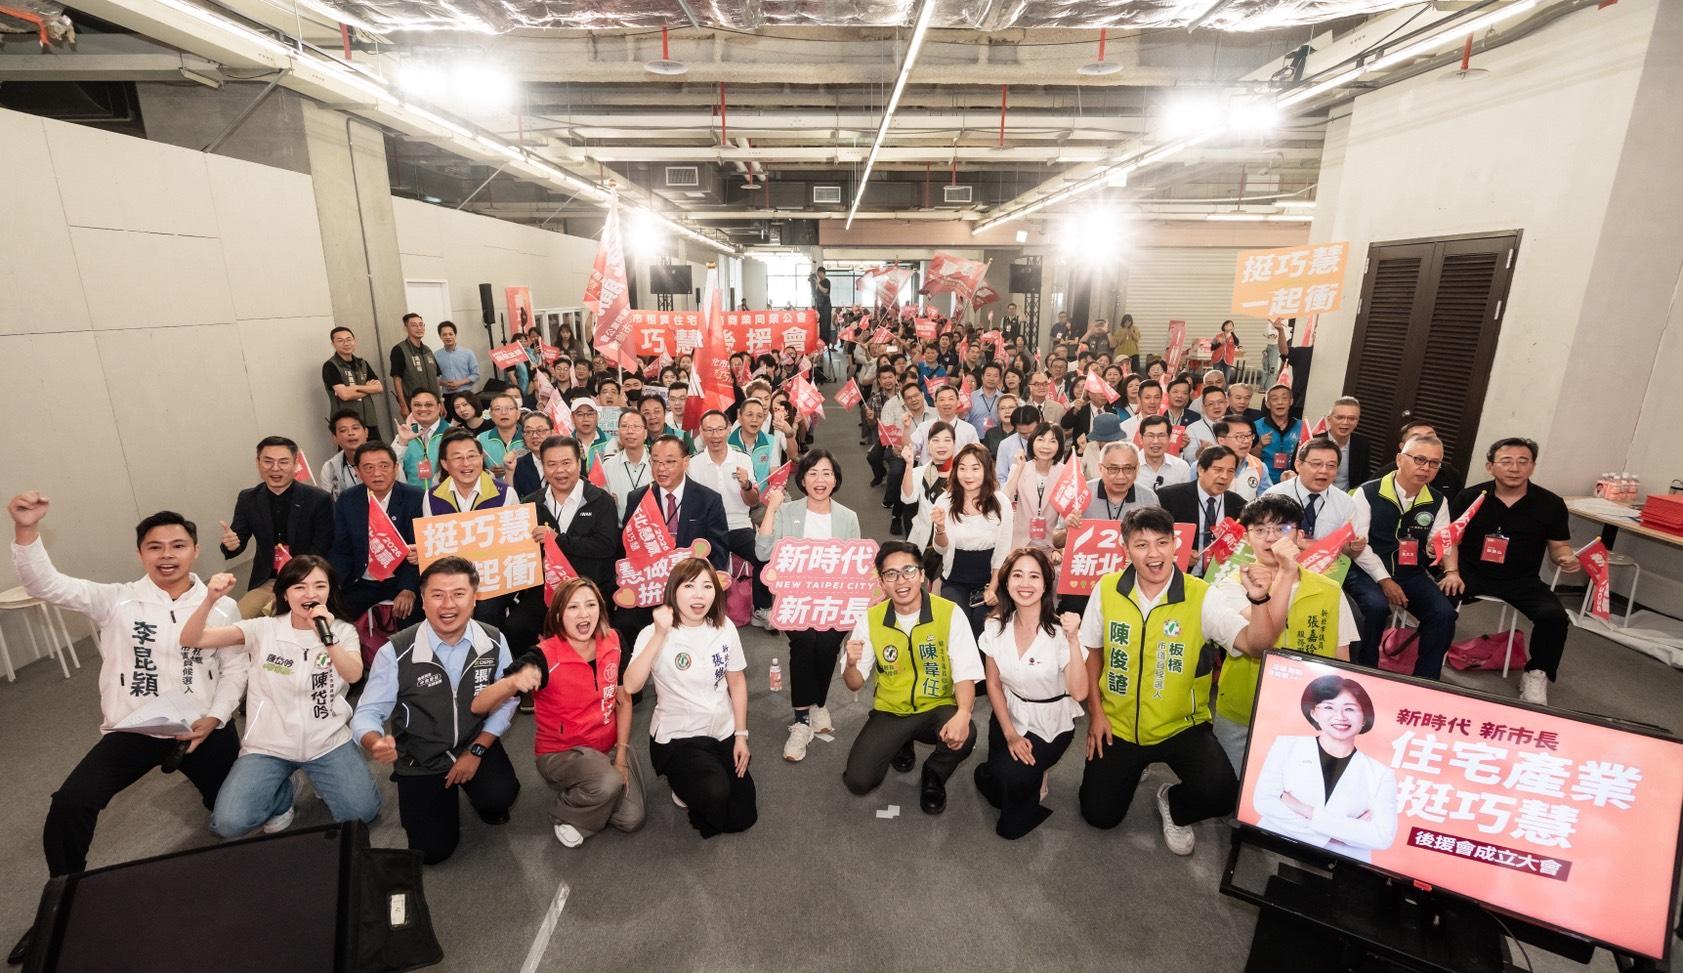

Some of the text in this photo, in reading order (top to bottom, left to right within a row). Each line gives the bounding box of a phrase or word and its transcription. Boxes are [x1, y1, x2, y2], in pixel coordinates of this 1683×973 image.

[1240, 245, 1344, 283] 挺巧慧
[1240, 284, 1339, 316] 一起衝
[383, 536, 402, 558] 2026
[424, 508, 531, 558] 挺巧慧
[654, 528, 671, 551] 2026
[476, 553, 537, 592] 起衝
[775, 544, 873, 575] 新時代
[777, 596, 871, 625] 新市長
[130, 621, 159, 697] 李昆穎
[1109, 621, 1130, 695] 陳俊諺
[1167, 642, 1184, 673] 板橋
[311, 671, 329, 720] 陳岱吟
[1396, 708, 1560, 751] 新時代 新市長
[1390, 730, 1643, 810] 住宅產業
[1396, 775, 1580, 849] 挺巧慧
[1414, 830, 1563, 877] 後援會成立大會
